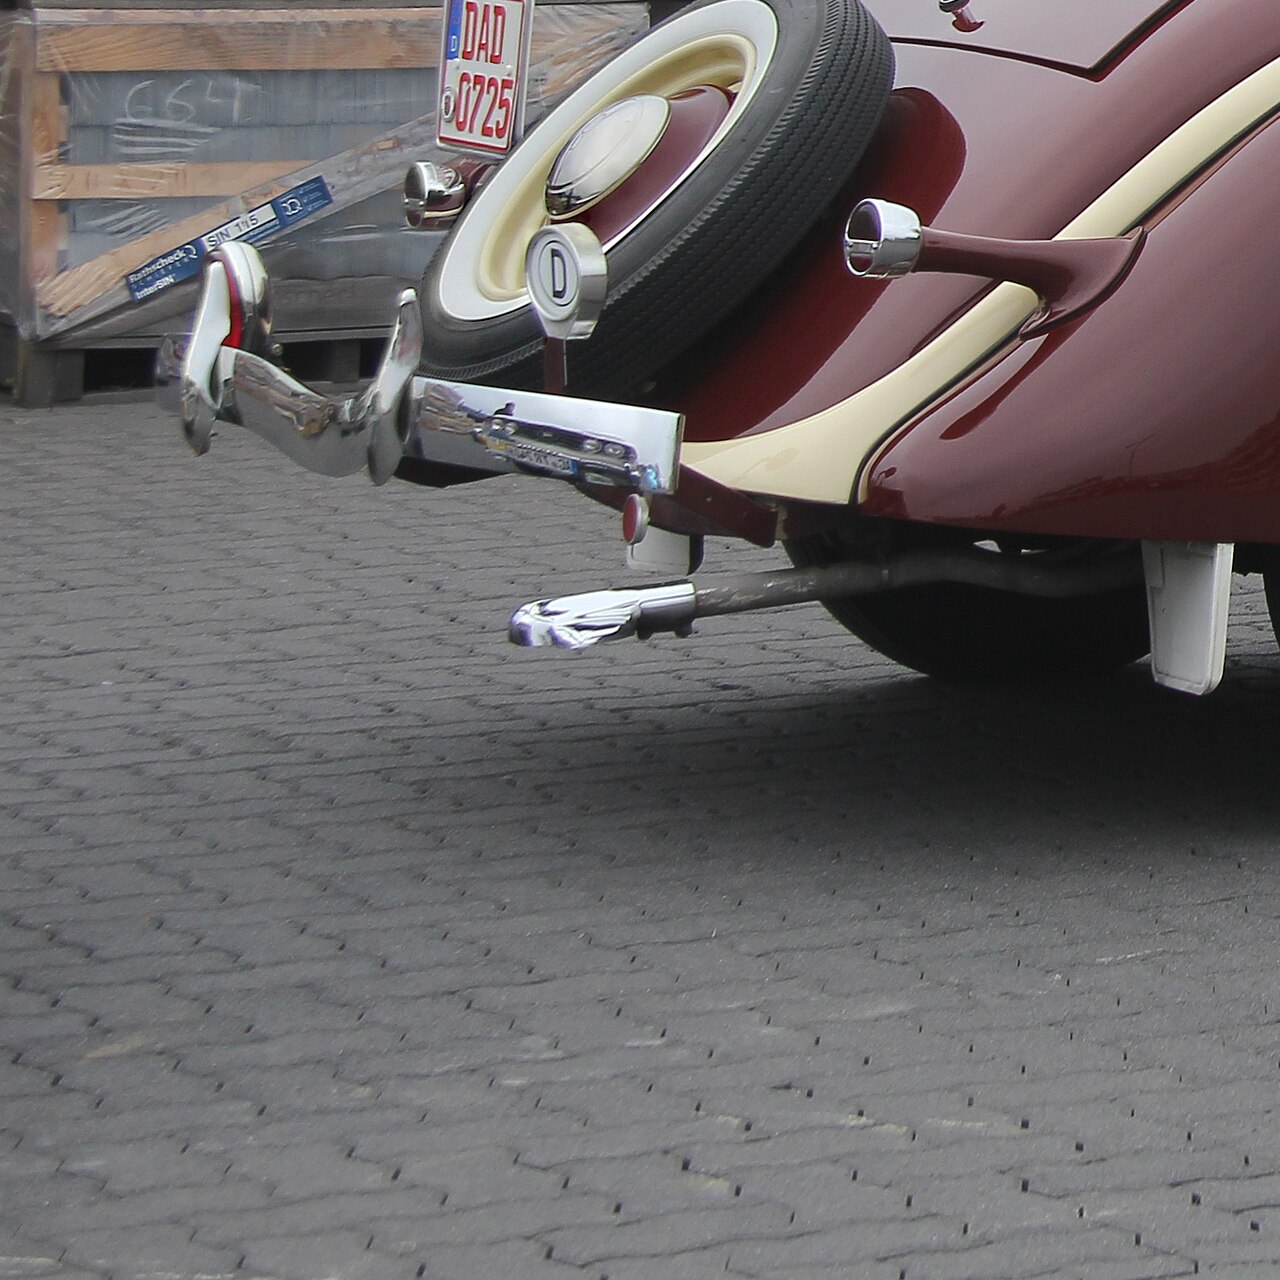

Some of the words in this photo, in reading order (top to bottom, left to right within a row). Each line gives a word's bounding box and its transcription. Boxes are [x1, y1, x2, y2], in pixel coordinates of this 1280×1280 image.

[450, 35, 458, 52] D
[462, 1, 507, 65] DAD
[455, 72, 514, 139] 0725
[207, 228, 231, 247] SIN
[235, 214, 260, 233] 115
[128, 249, 187, 284] Rathscheck
[551, 247, 567, 299] D
